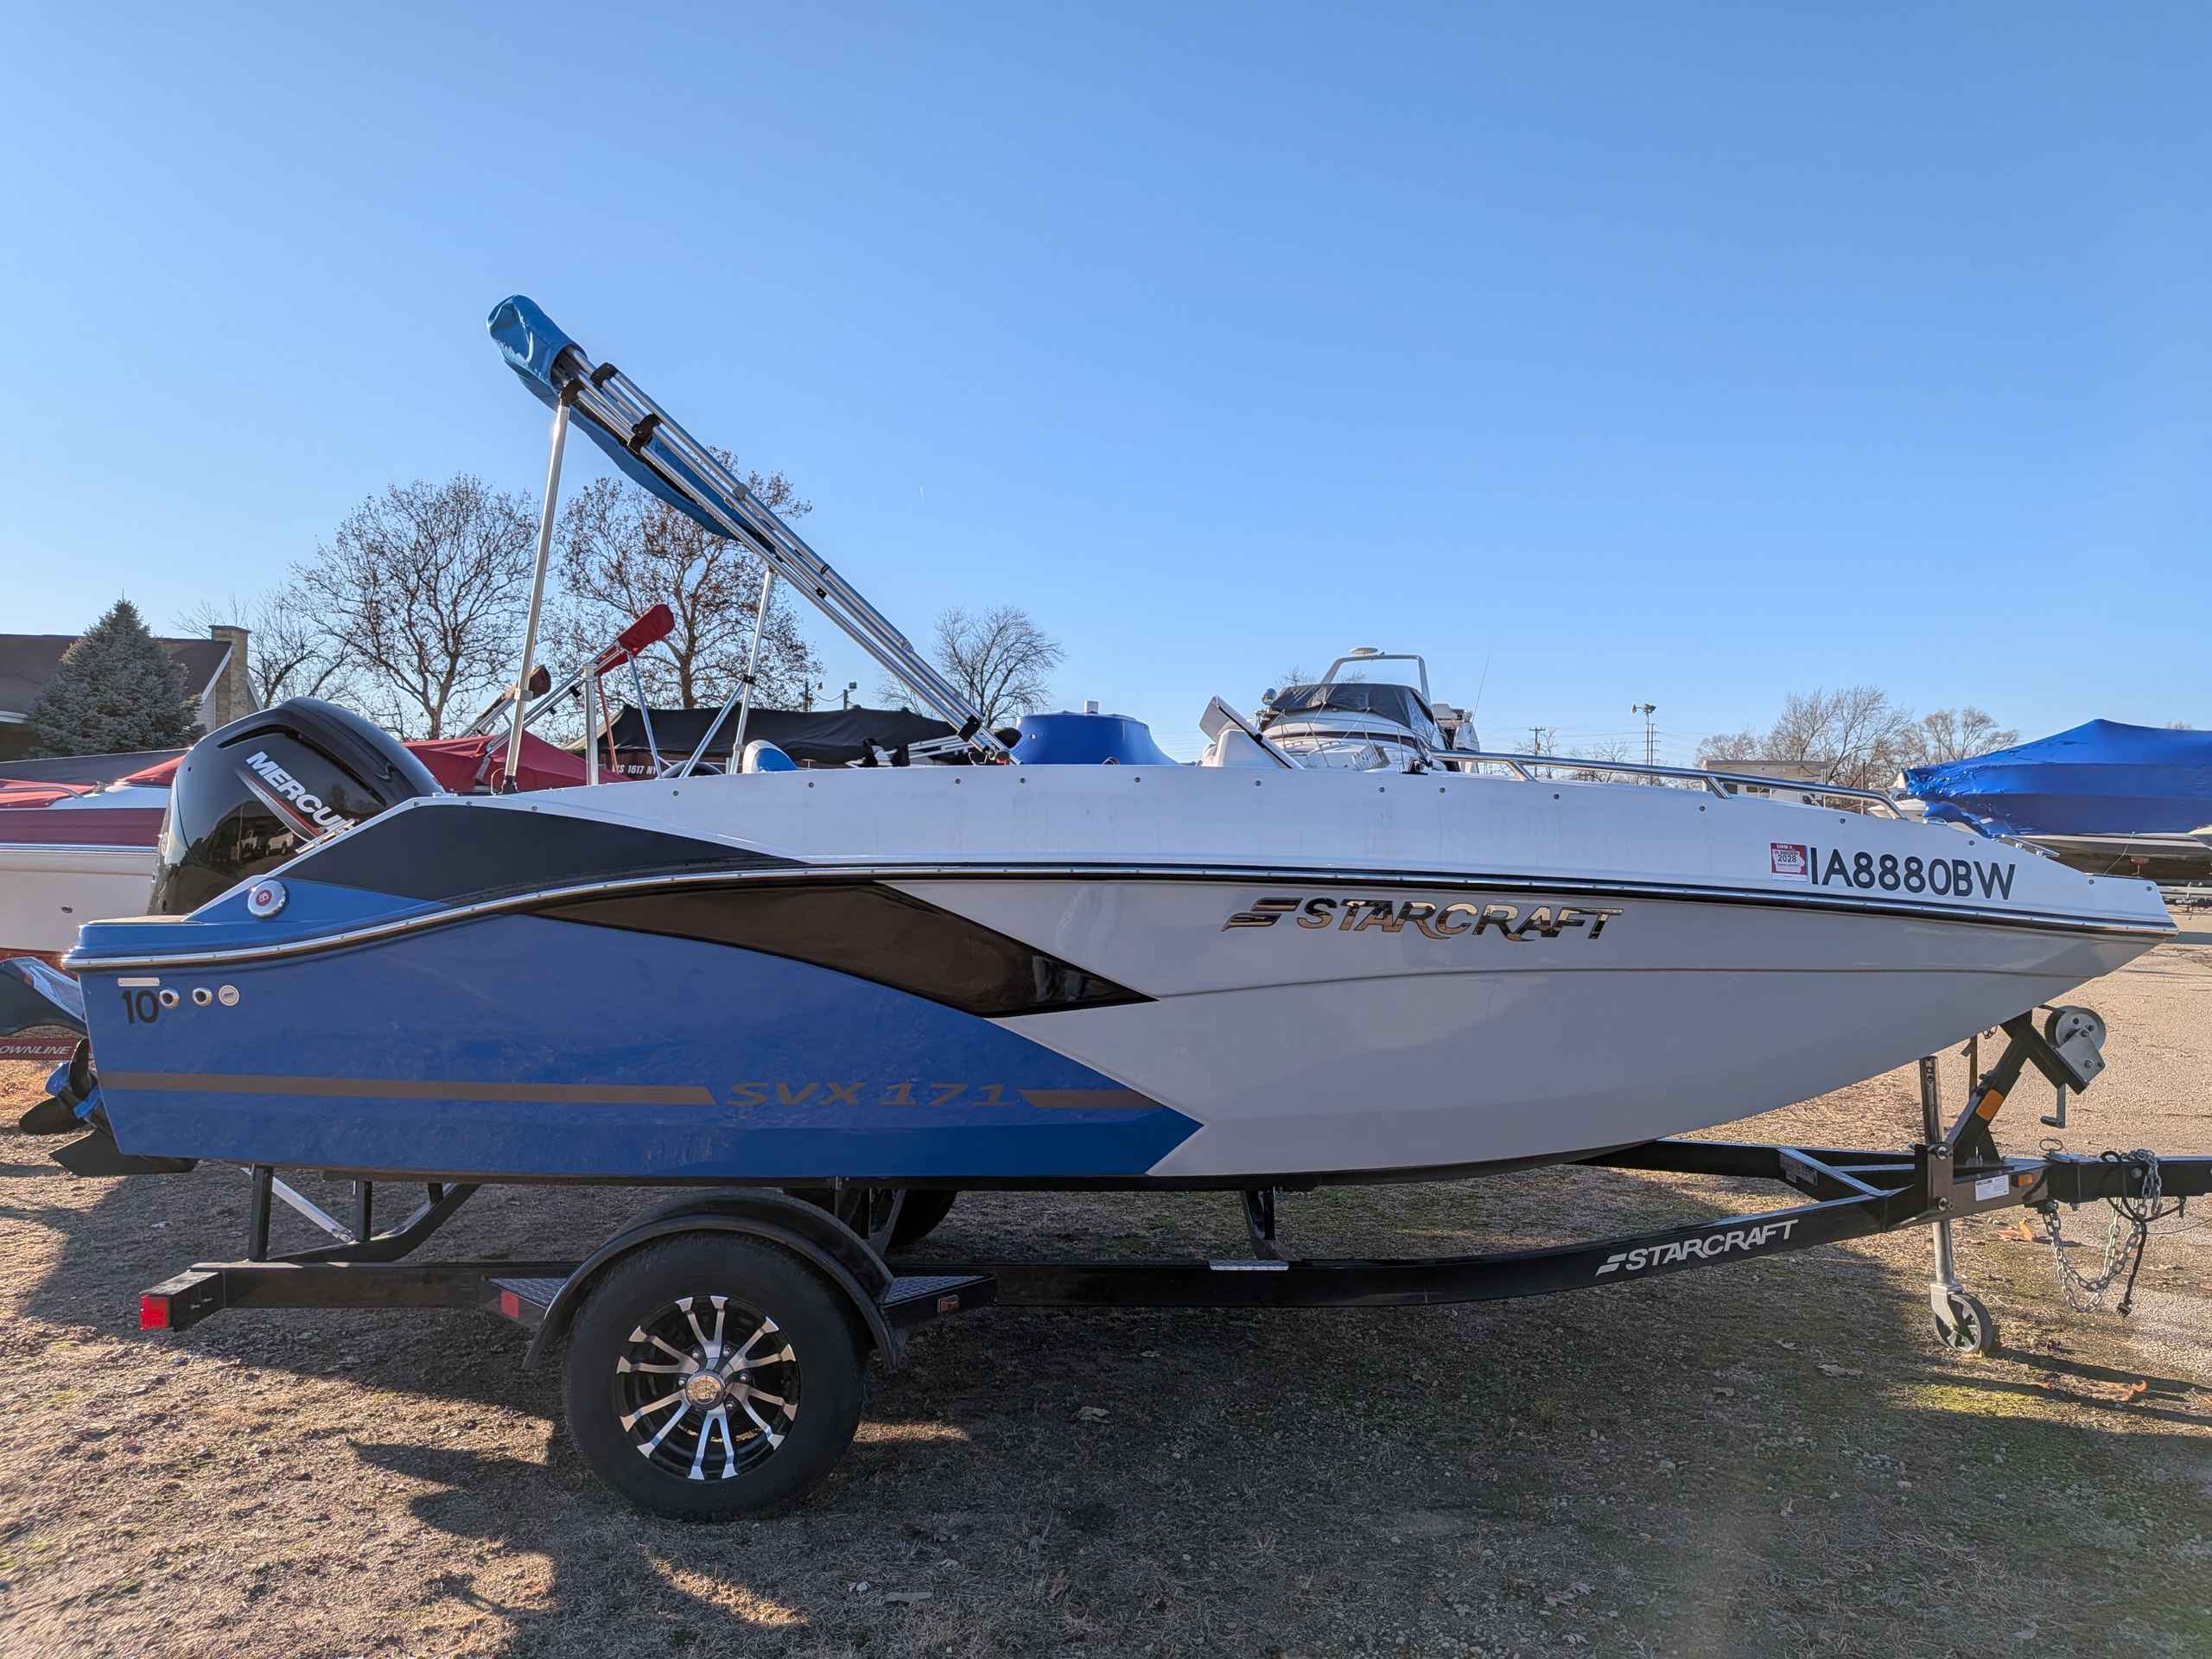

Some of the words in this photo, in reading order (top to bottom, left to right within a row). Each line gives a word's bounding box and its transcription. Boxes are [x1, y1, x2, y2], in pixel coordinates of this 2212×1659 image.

[245, 750, 351, 835] MERCU
[1810, 847, 2016, 900] IA8880BW
[1296, 897, 1624, 942] STARCRAFT
[121, 989, 159, 1024] 10
[727, 1081, 866, 1107] SVX
[878, 1081, 1011, 1107] 171
[1624, 1218, 1799, 1271] STARCRAFT
